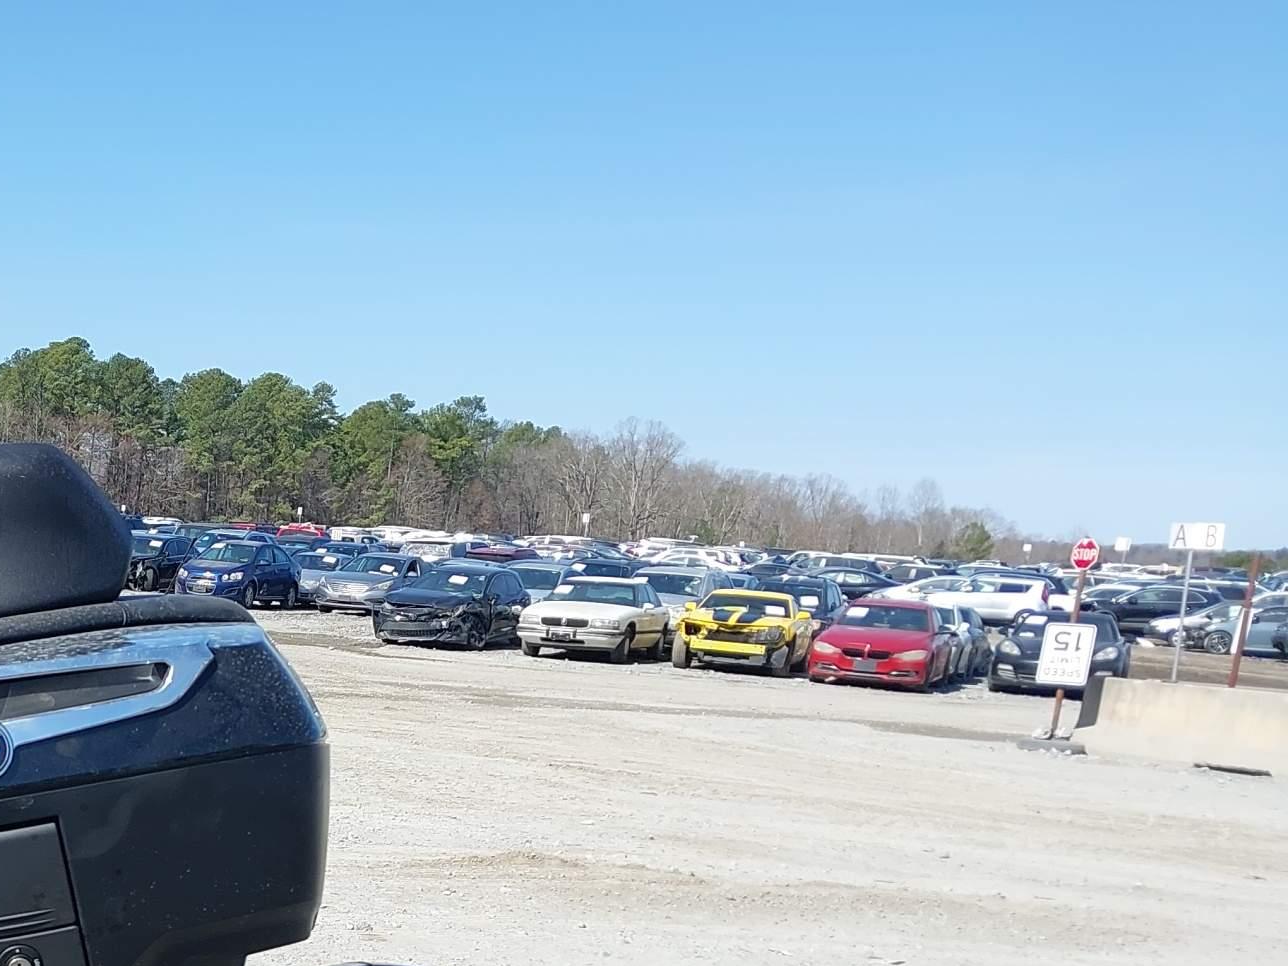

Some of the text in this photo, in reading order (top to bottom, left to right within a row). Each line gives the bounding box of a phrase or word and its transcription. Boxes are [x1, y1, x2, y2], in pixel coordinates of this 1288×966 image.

[1173, 524, 1217, 547] A B
[1072, 547, 1097, 561] STOP
[1053, 631, 1082, 652] 15
[1049, 656, 1081, 664] LIMIT
[1043, 667, 1081, 679] SPEED
